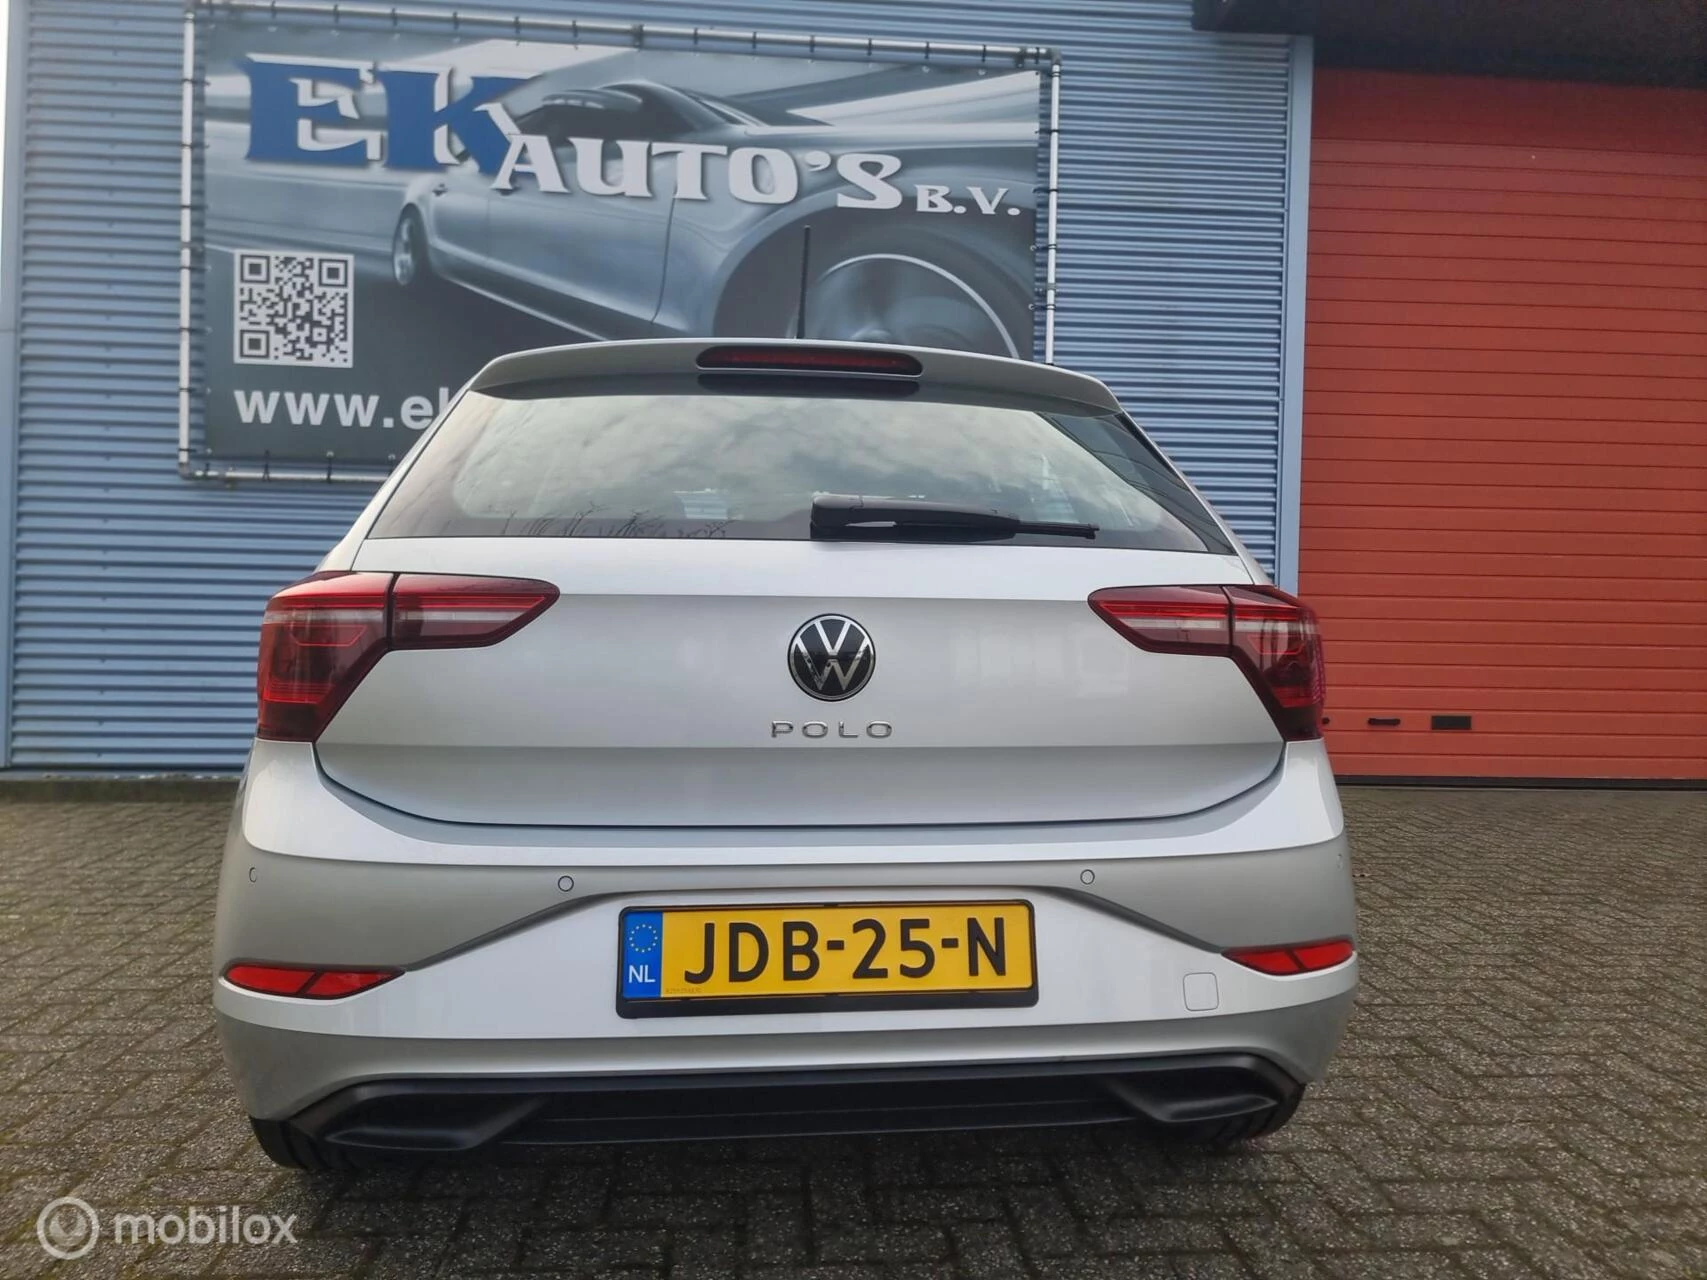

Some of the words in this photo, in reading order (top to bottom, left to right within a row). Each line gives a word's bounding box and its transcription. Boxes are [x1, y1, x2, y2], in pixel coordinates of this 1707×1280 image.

[242, 53, 542, 175] EK
[491, 134, 902, 210] AUTO'S
[915, 184, 1021, 216] B.V.
[771, 720, 893, 739] POLO
[684, 917, 1007, 984] JDB-25-N
[628, 964, 656, 984] NL
